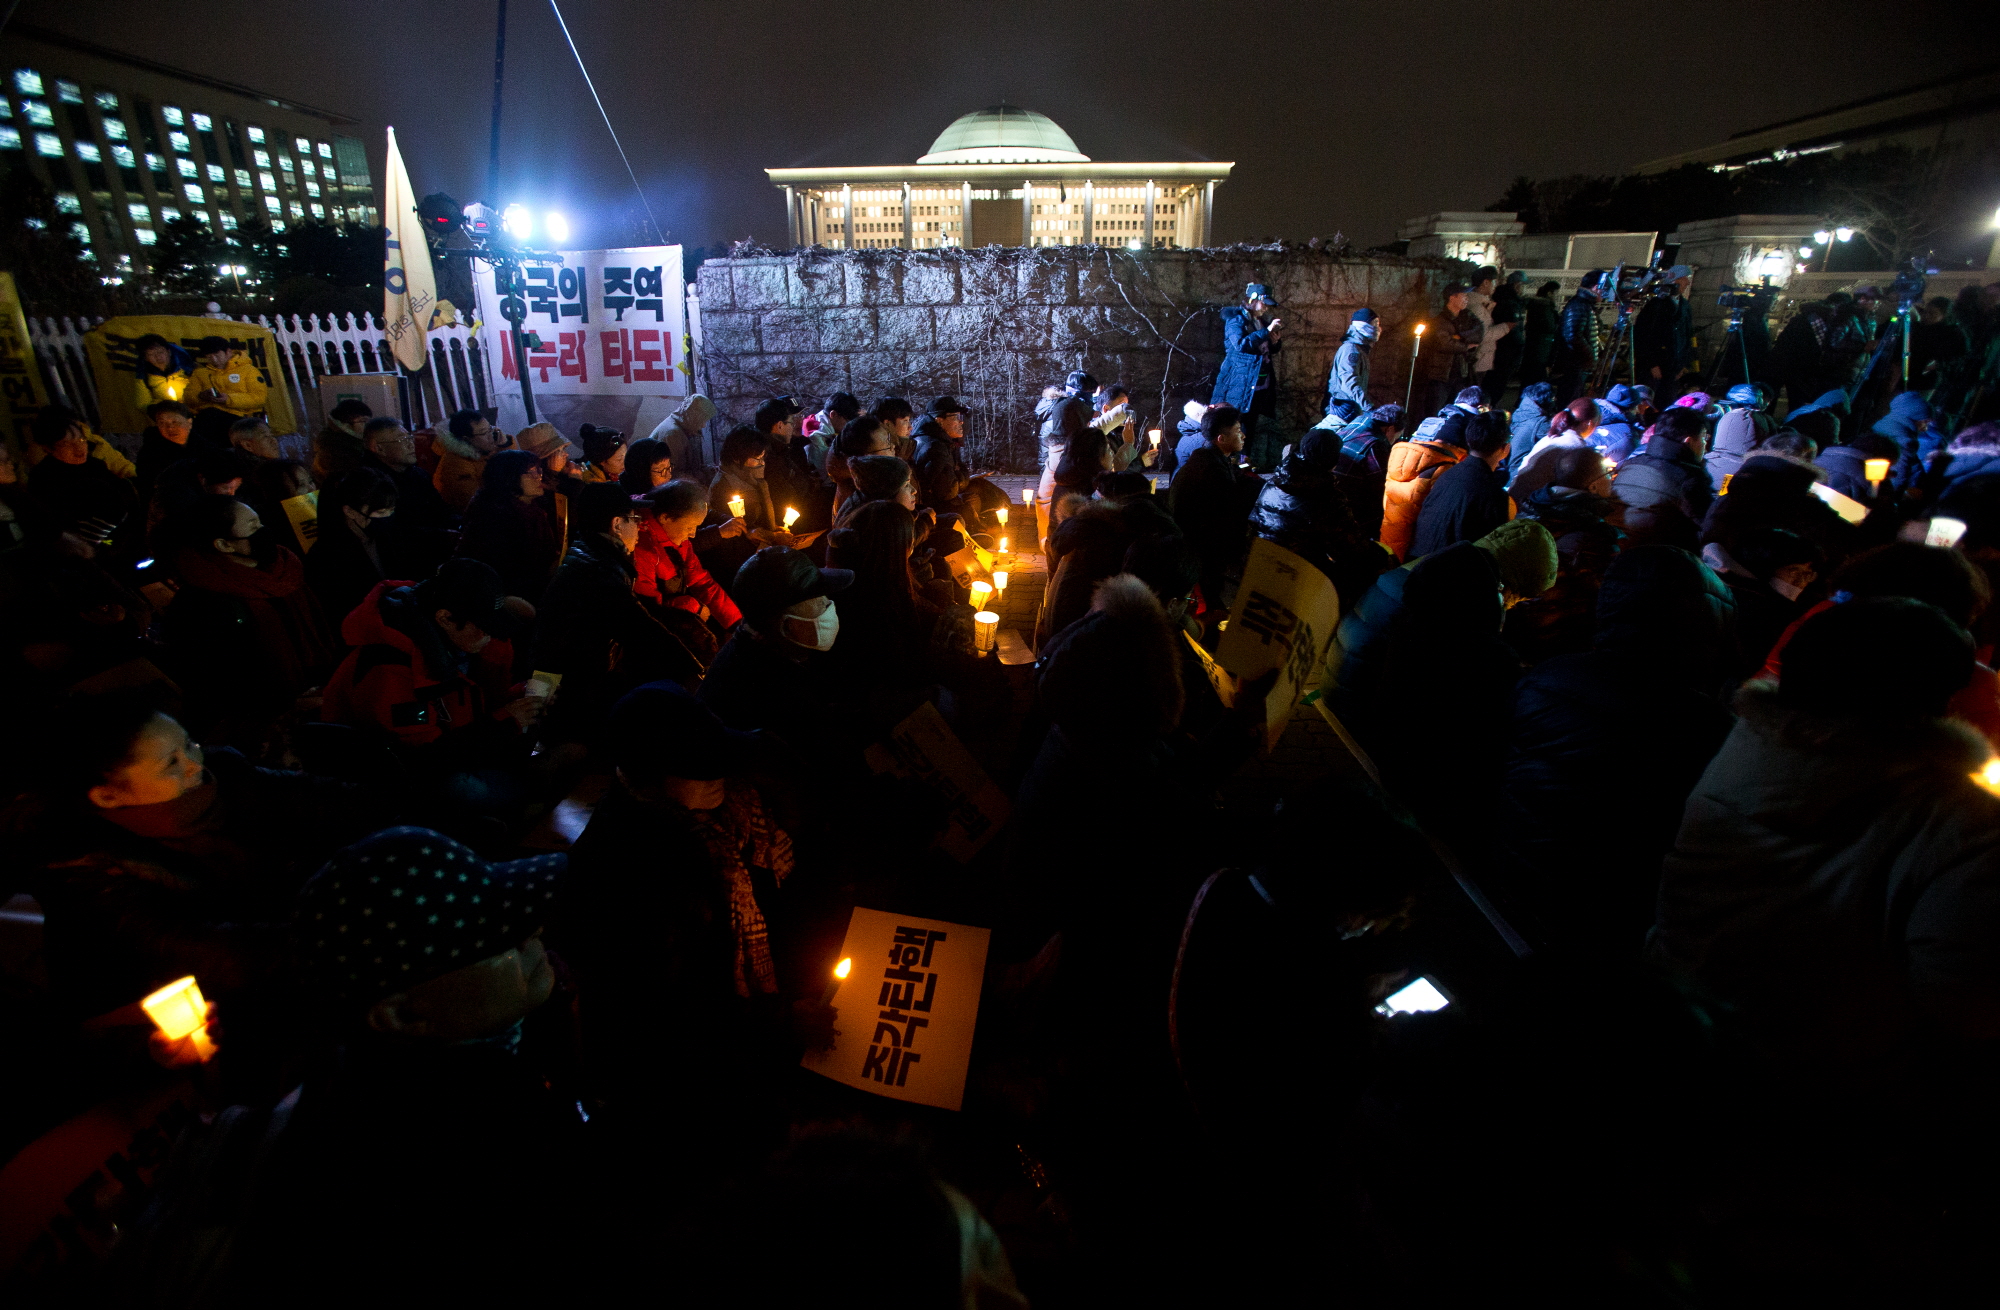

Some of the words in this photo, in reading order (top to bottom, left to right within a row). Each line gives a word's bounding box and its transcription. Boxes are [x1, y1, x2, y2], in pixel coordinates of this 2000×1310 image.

[603, 265, 664, 322] 주역
[600, 328, 674, 384] 타도!
[861, 925, 947, 1087] 즉각탄핵
